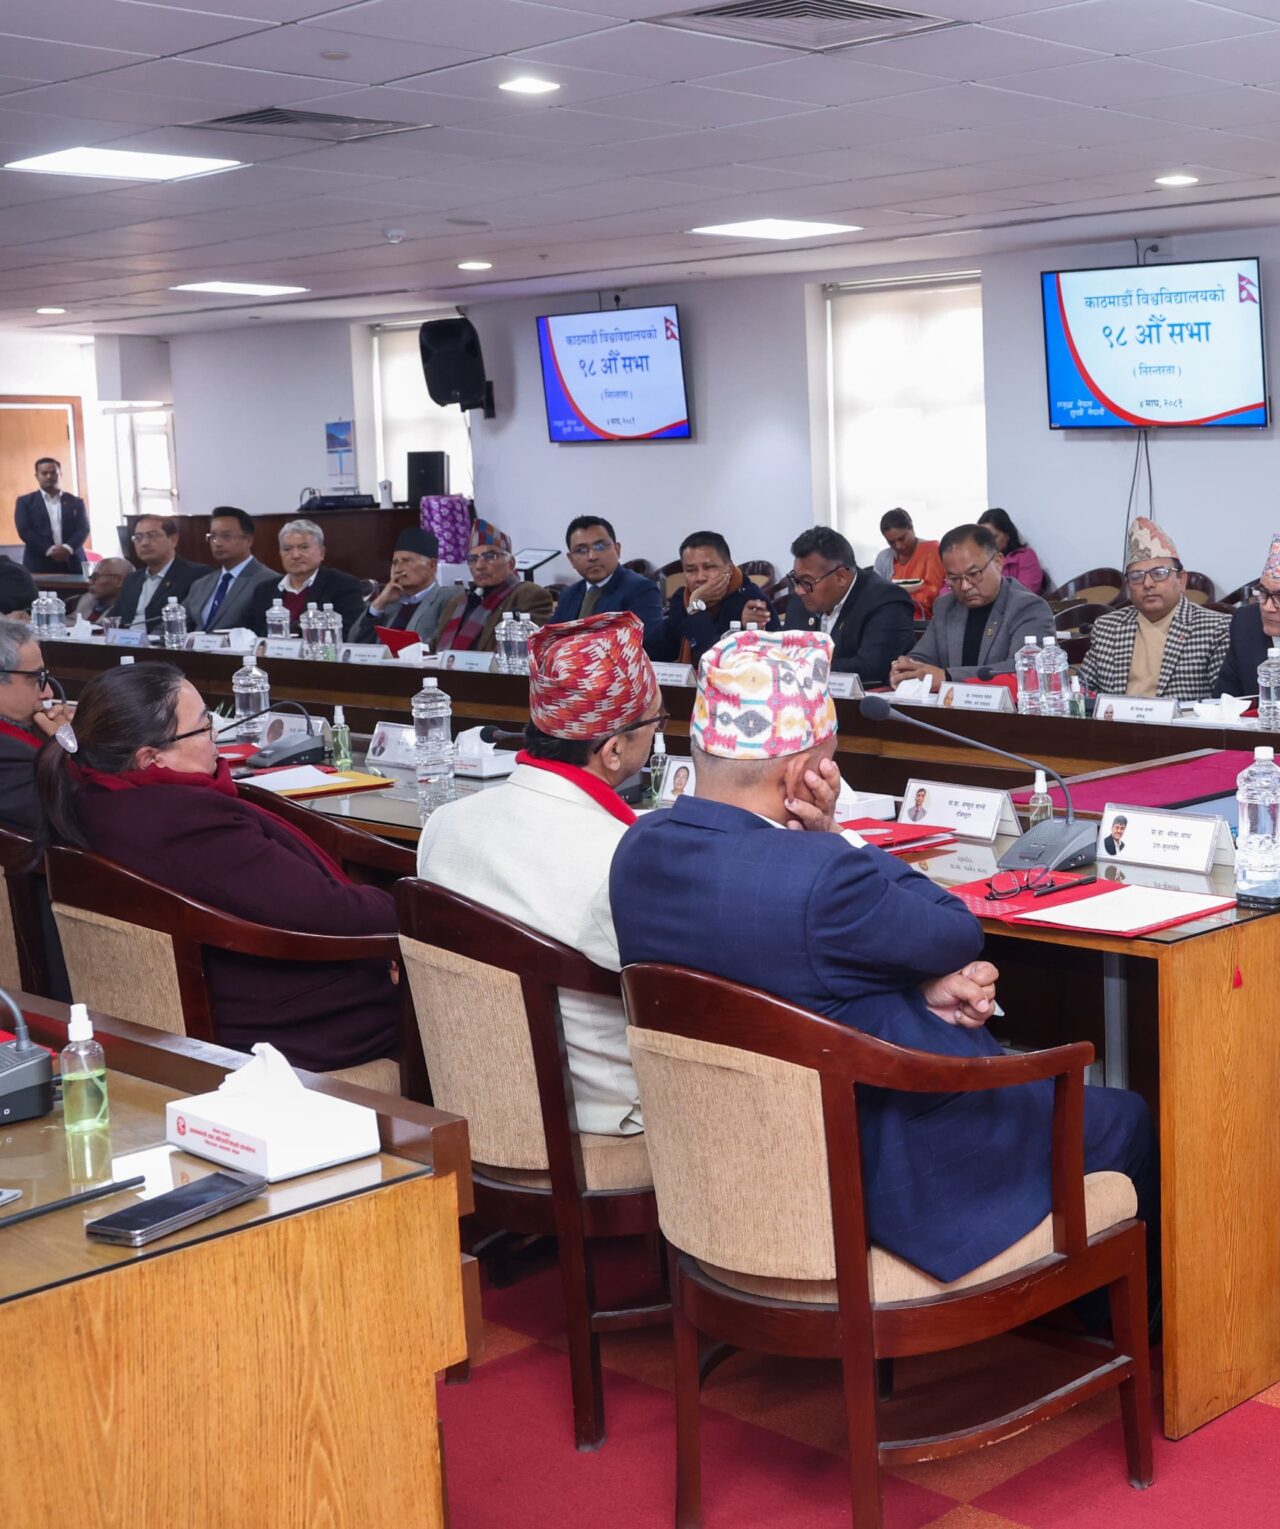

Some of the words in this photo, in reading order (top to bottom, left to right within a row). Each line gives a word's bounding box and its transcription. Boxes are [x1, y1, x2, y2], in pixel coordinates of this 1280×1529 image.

[1135, 283, 1226, 307] विश्वविद्यालयको
[1101, 325, 1128, 349] ९८
[1167, 321, 1212, 344] सभा
[579, 359, 597, 377] ९८
[621, 355, 650, 374] सभा
